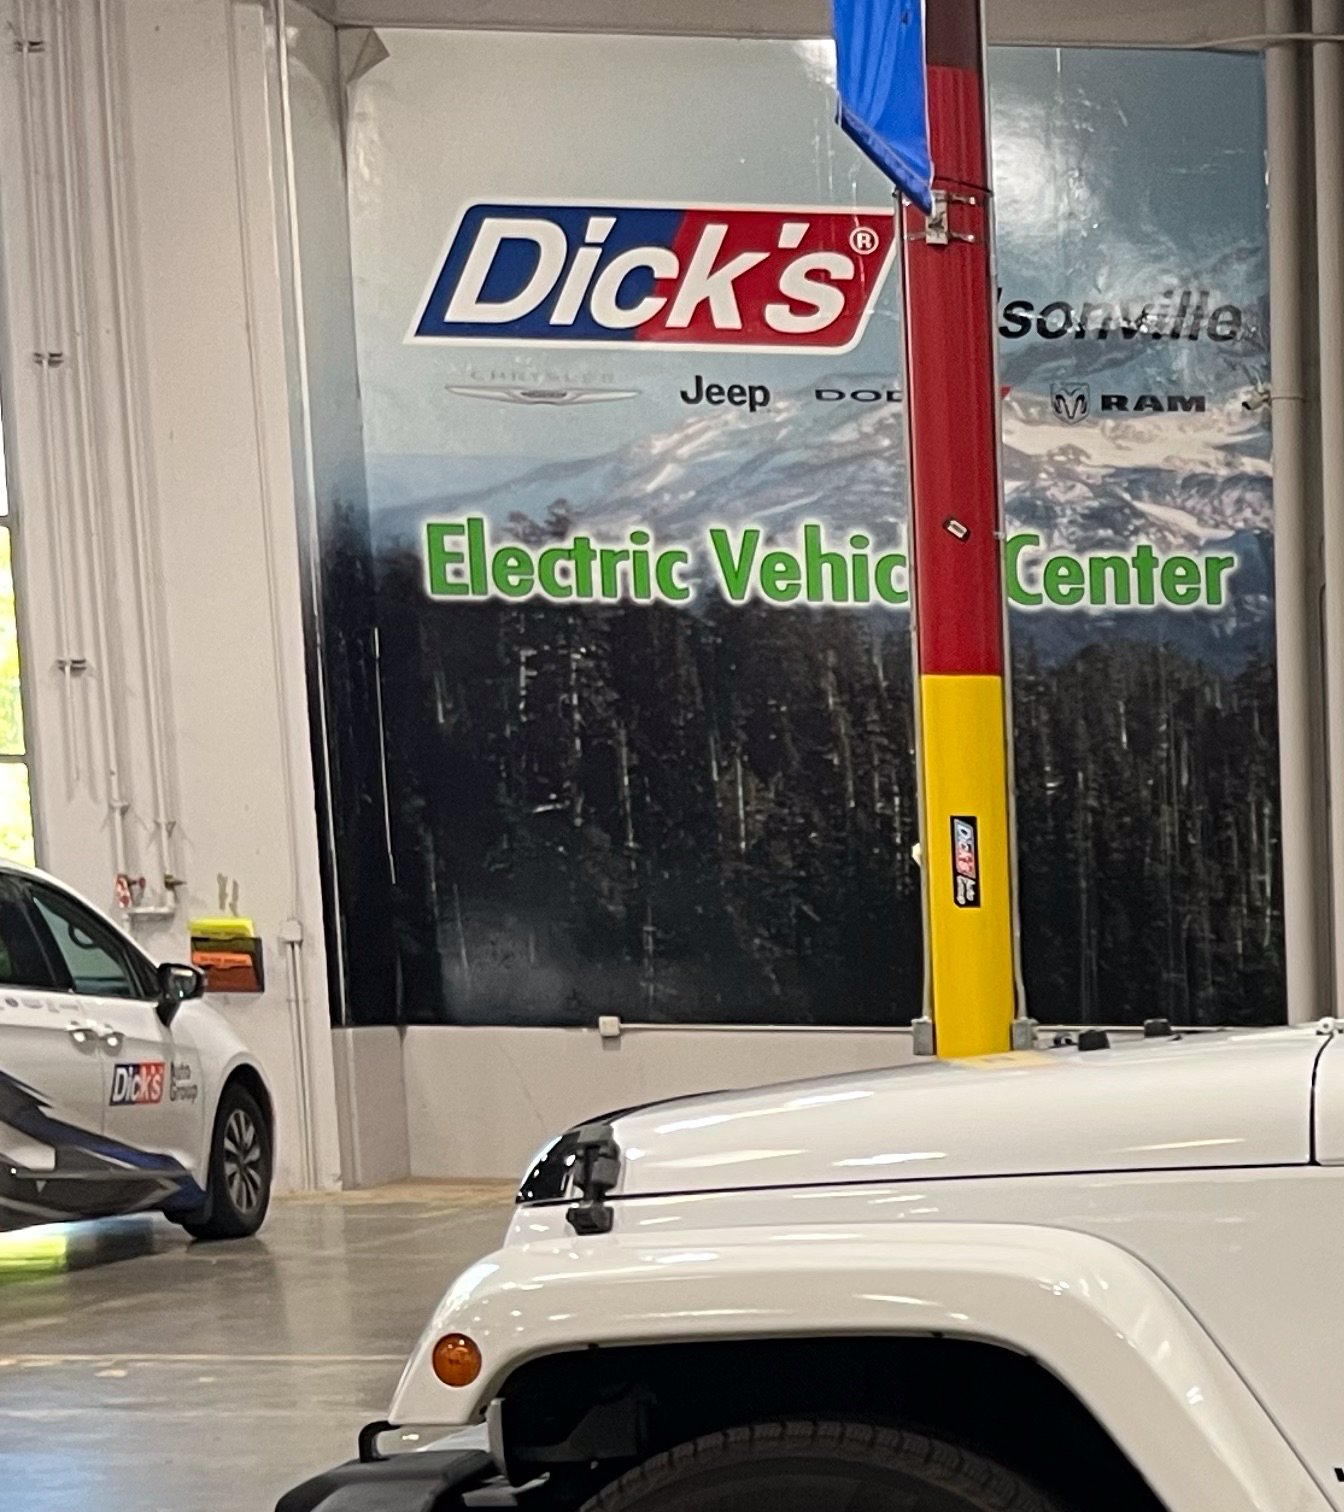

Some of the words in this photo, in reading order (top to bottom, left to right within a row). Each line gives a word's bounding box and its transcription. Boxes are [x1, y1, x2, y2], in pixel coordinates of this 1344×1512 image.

[444, 216, 855, 334] Dick's
[997, 287, 1243, 342] sonville
[680, 374, 770, 412] Jeep
[814, 388, 904, 403] DOD
[1101, 394, 1206, 412] RAM
[426, 516, 690, 600] Electric
[709, 524, 909, 603] Vehic
[1006, 533, 1235, 606] Center
[112, 1065, 161, 1102] Dick's
